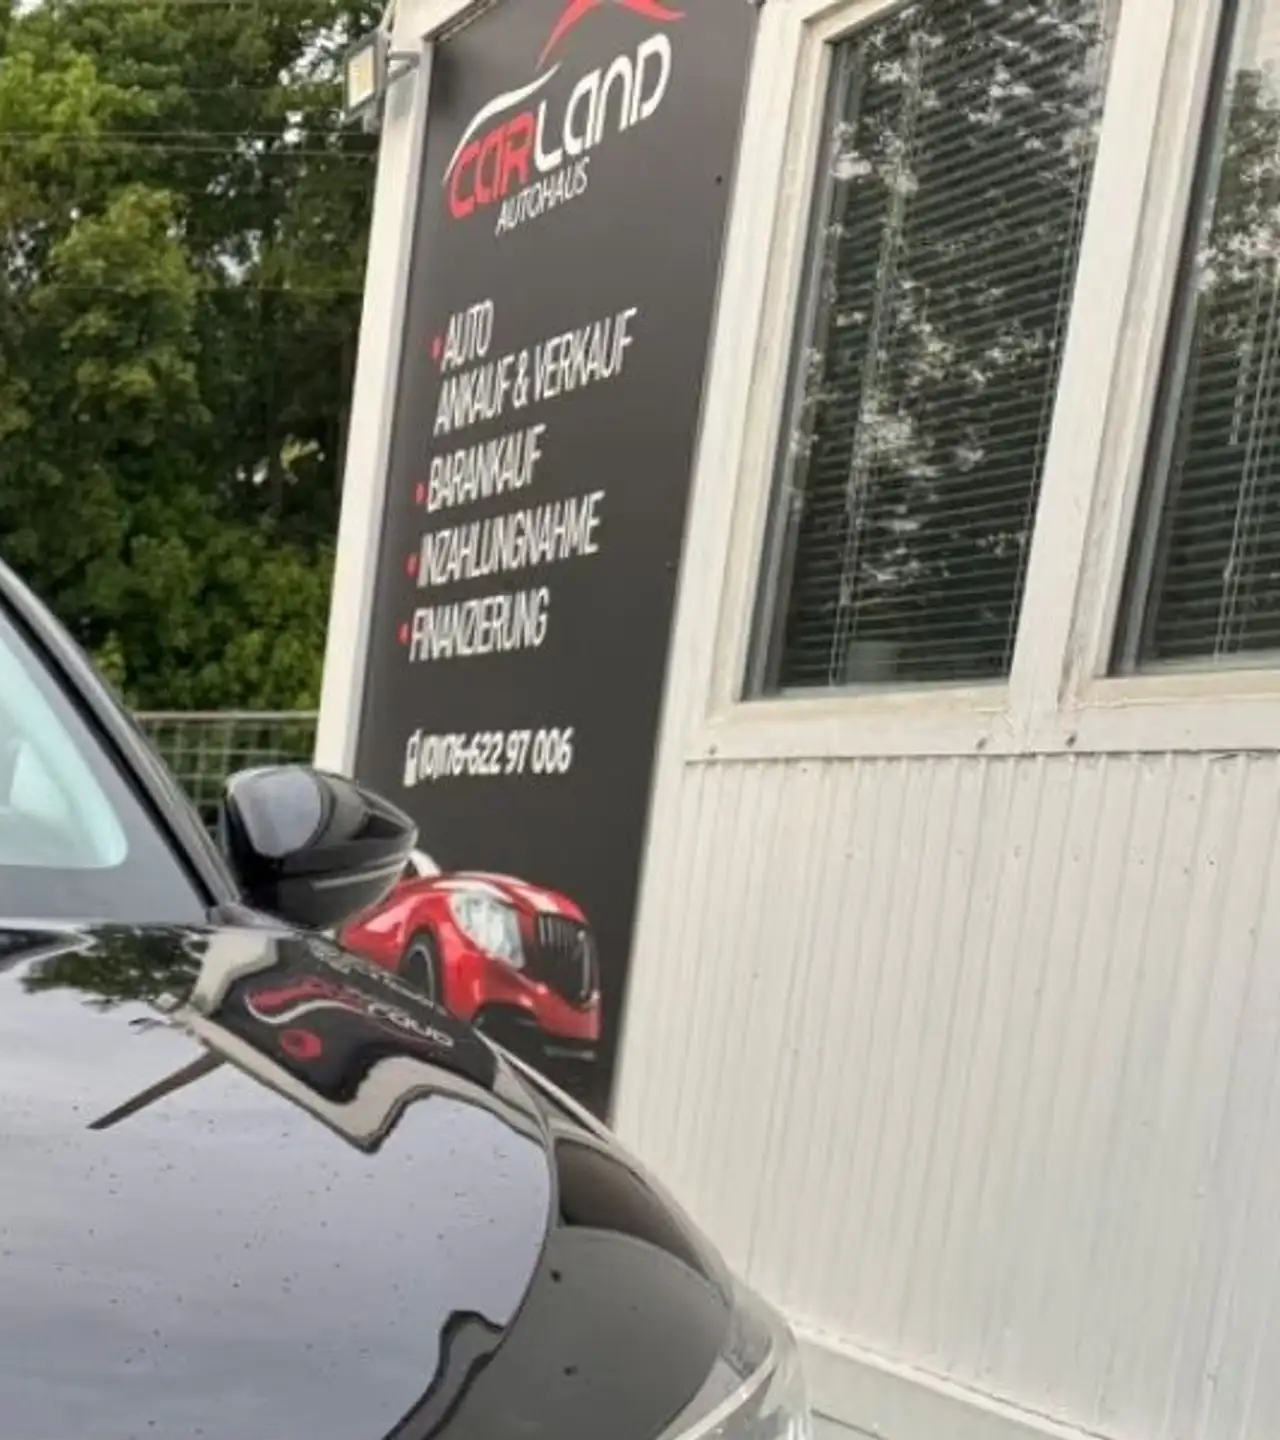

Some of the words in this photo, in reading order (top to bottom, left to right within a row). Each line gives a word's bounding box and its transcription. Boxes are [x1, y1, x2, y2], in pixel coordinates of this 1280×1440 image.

[495, 156, 589, 236] AUTOHAUS
[433, 354, 515, 437] ANKAUF
[512, 348, 531, 410] &
[534, 307, 638, 402] VERKAUF
[441, 298, 494, 376] AUTO
[426, 423, 547, 514] BARANKAUF
[416, 490, 606, 589] INZAHLUNGNAHME
[409, 585, 550, 663] FINANZIERUNG
[504, 729, 532, 775] 97
[532, 726, 575, 775] 006
